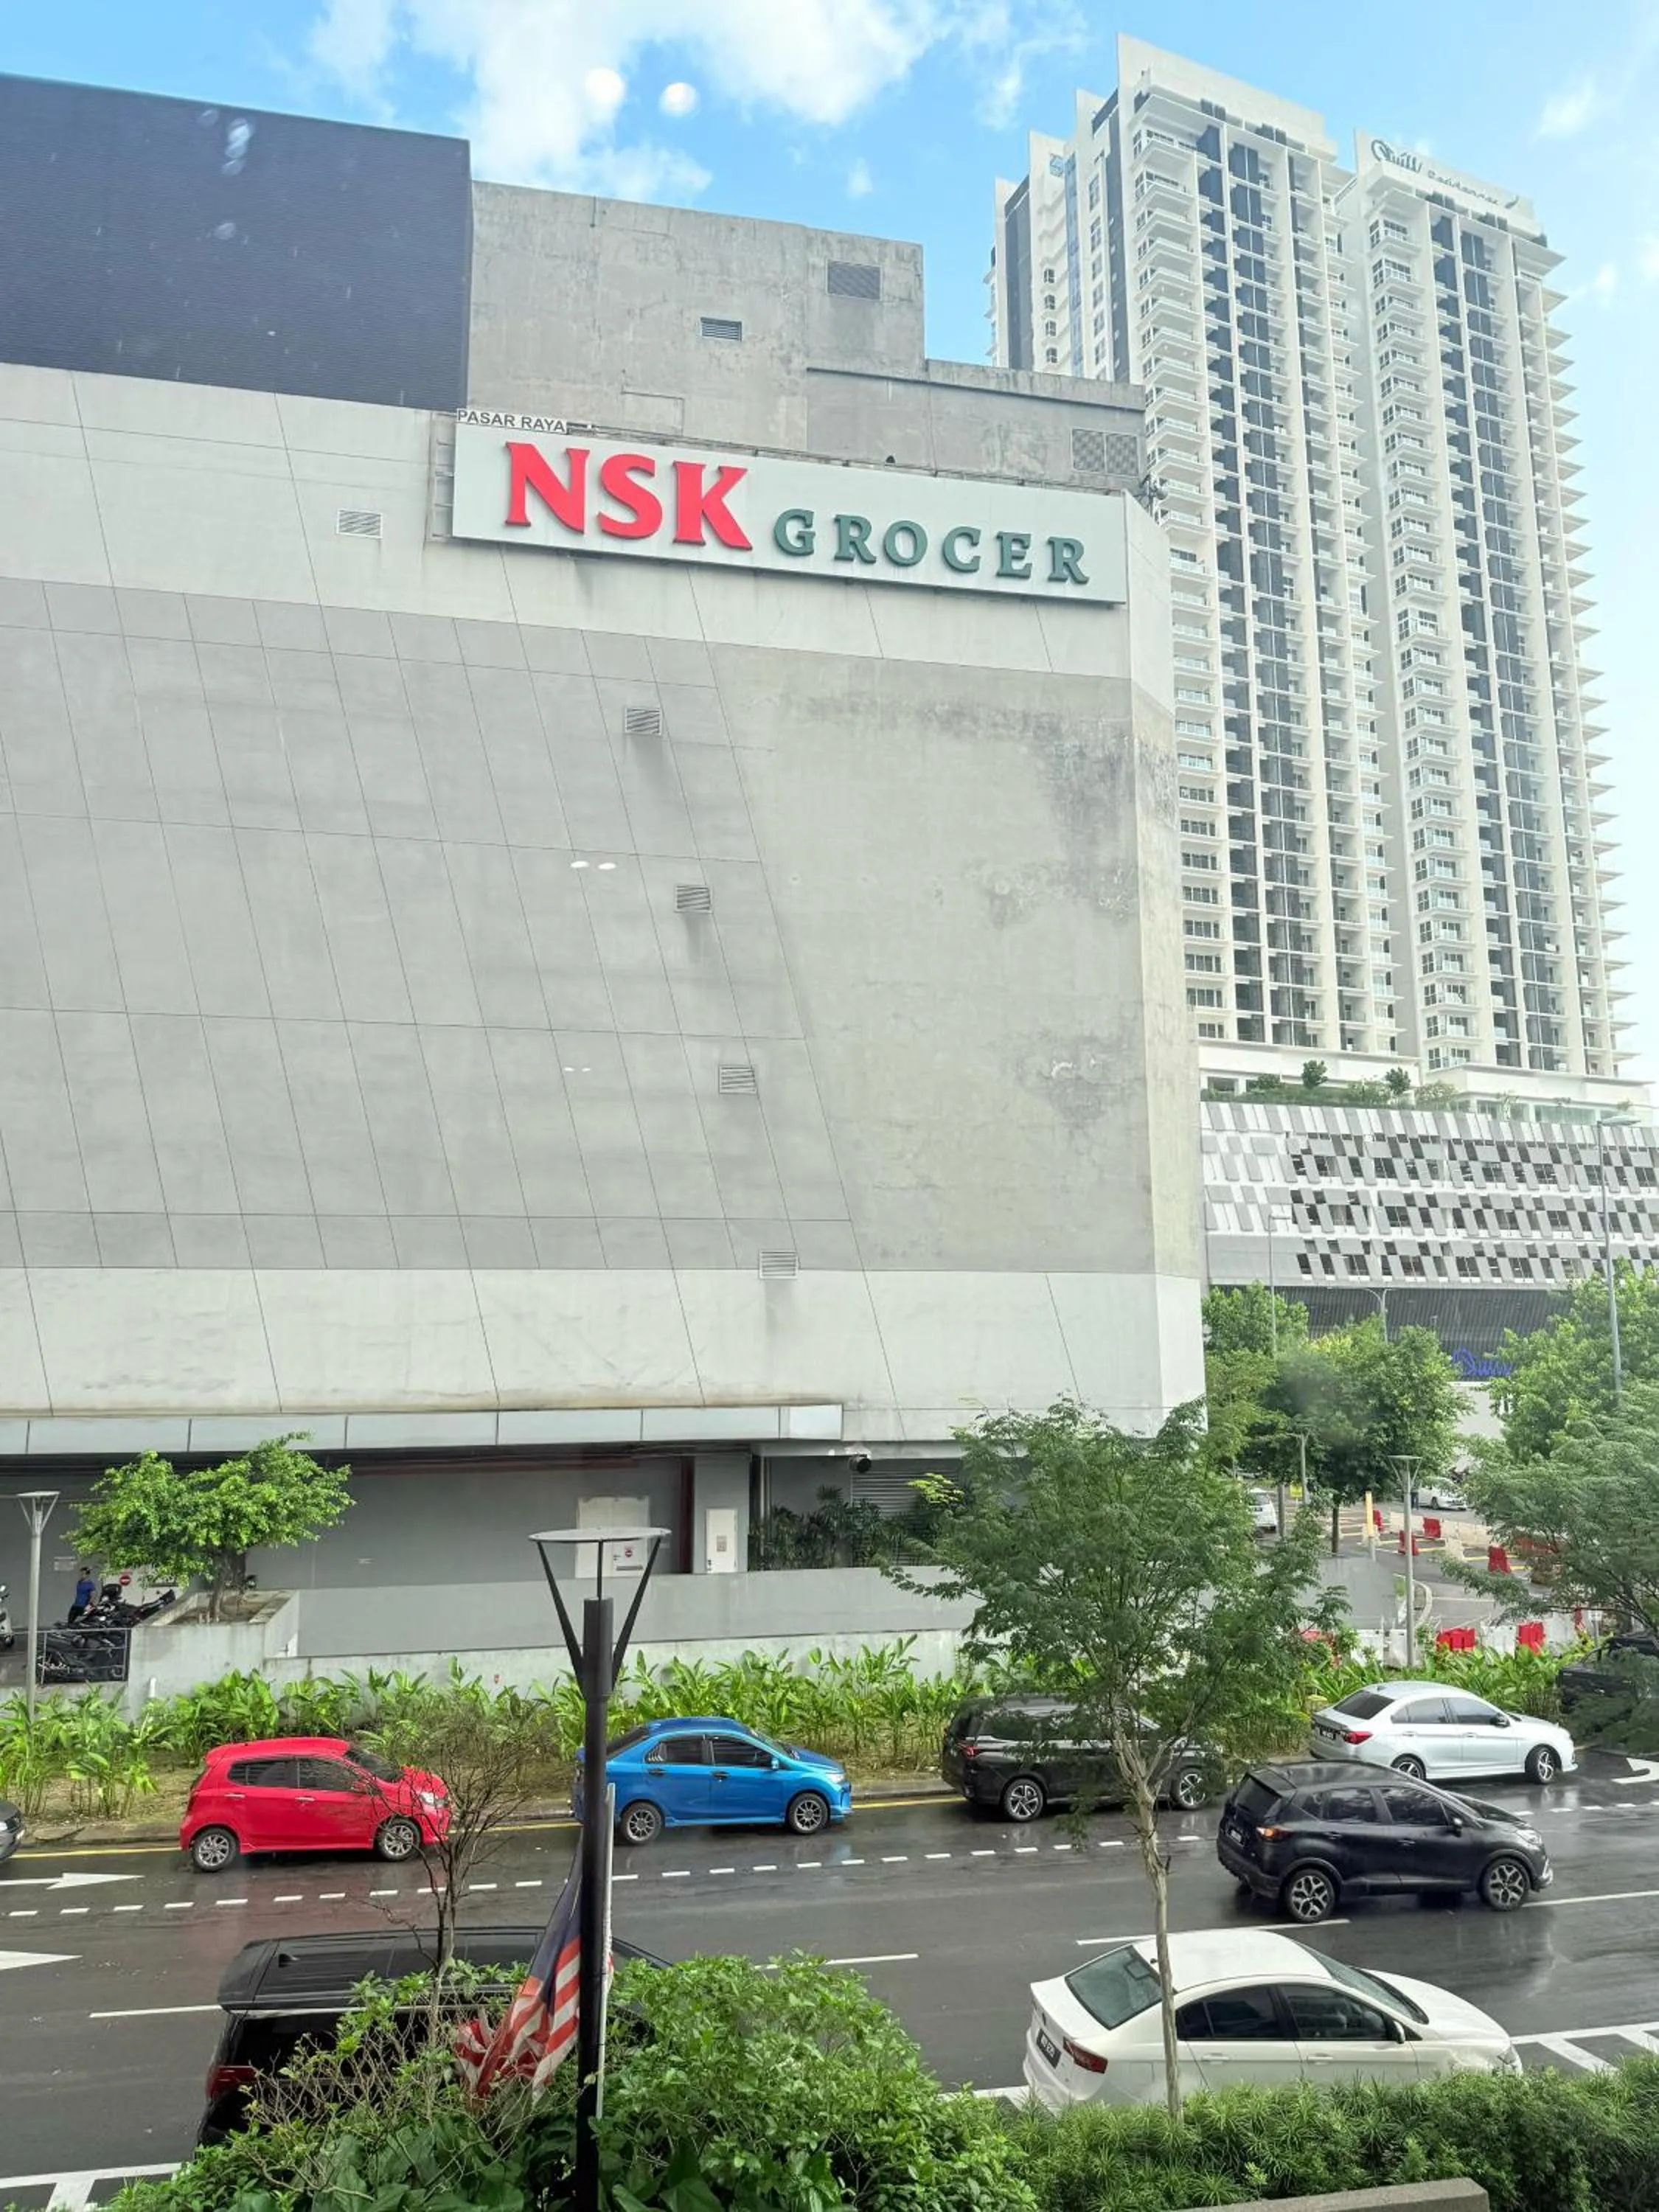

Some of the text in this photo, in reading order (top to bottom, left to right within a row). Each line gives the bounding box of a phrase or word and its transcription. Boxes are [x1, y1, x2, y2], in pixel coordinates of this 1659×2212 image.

[457, 409, 566, 432] PASAR RAYA
[505, 442, 1090, 585] NSK GROCER
